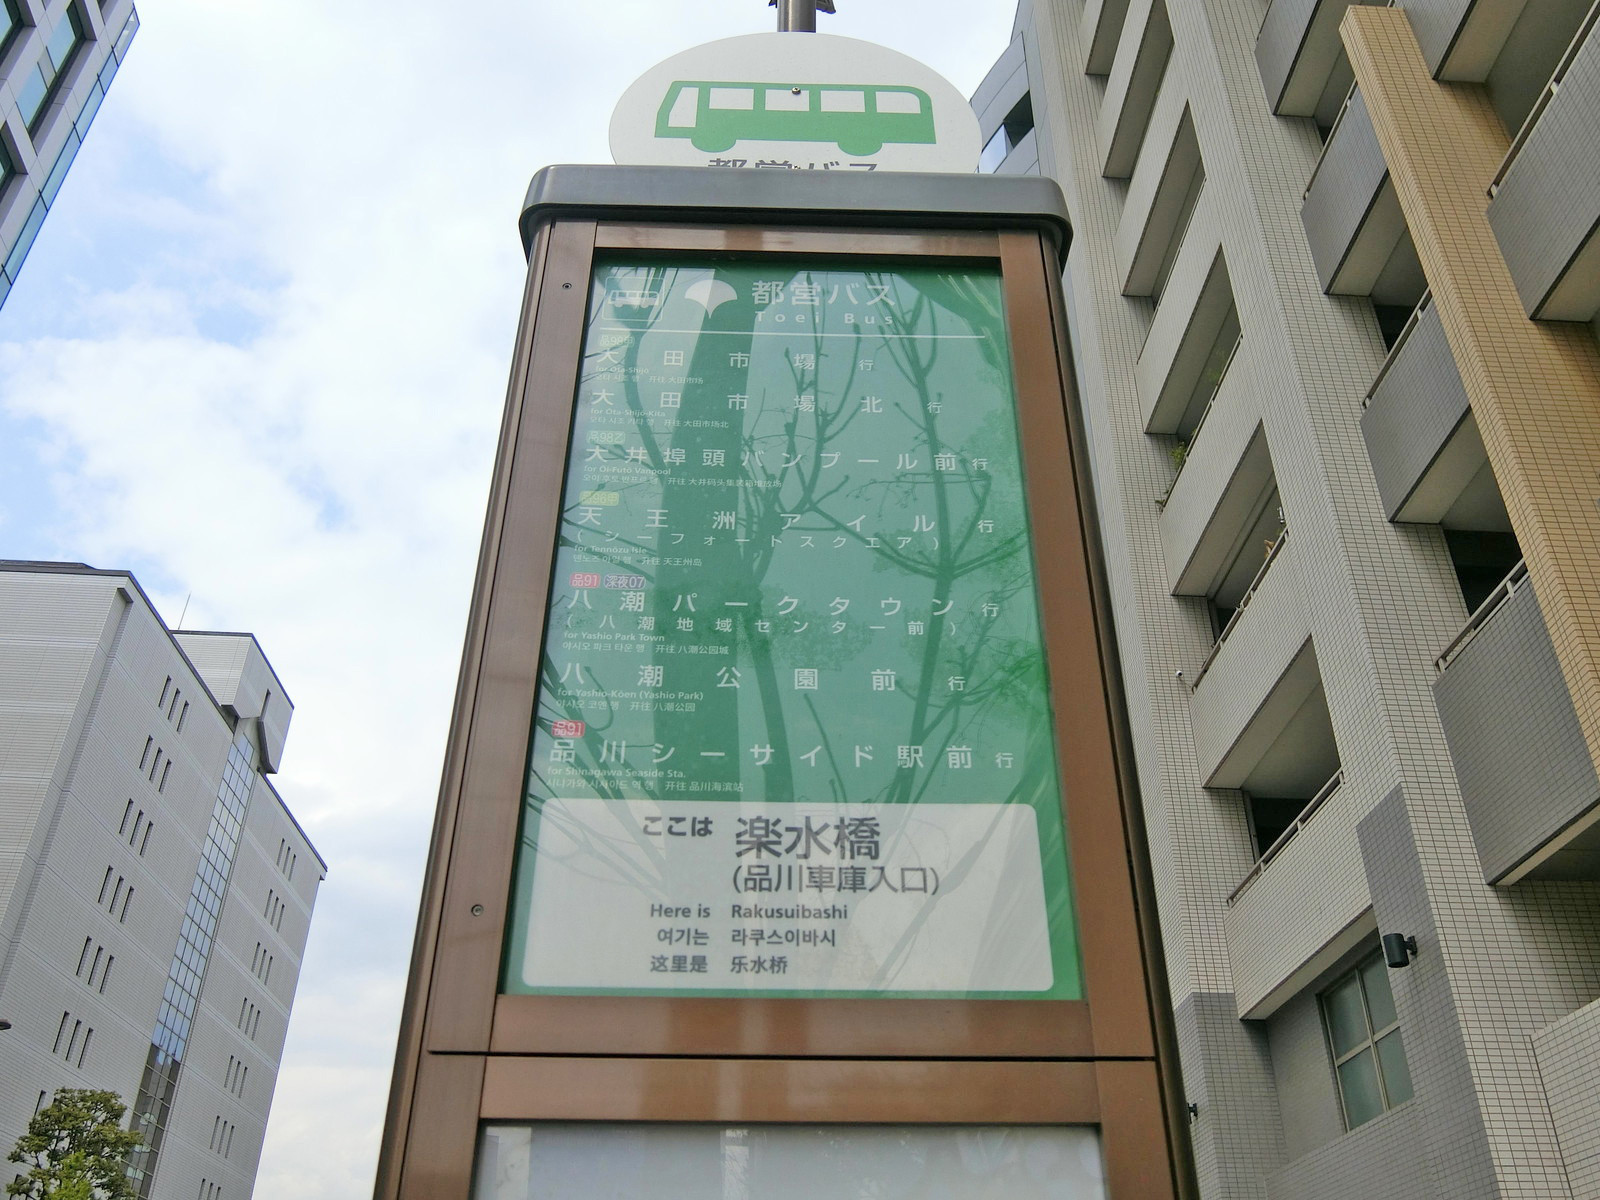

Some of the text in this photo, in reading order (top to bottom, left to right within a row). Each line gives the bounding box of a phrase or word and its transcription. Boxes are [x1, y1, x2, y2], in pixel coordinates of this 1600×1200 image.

[751, 280, 896, 306] 都営バス
[754, 311, 893, 324] Toei Bus
[635, 467, 672, 476] Vanpool
[574, 544, 587, 552] for
[631, 546, 647, 554] Isle
[571, 574, 598, 587] 品91
[605, 575, 645, 588] 深夜07
[563, 631, 665, 642] for Yashio Park Town
[635, 644, 645, 653] 행
[559, 662, 966, 691] 八潮公園前行
[557, 687, 574, 697] for
[639, 690, 676, 701] (Yashio
[678, 691, 704, 701] Park)
[609, 701, 619, 711] 행
[554, 721, 582, 736] 品91
[550, 739, 1014, 769] 品川シーサイド駅前行
[547, 766, 687, 778] for Shinagawa Seaside Sta.
[642, 815, 881, 861] ここは 楽水橋
[732, 864, 940, 896] (品川車庫入口)
[650, 903, 849, 920] Here is Rakusuibashi
[657, 927, 837, 947] 여기는 라쿠스이바시
[650, 955, 789, 975] 这里是 乐水桥
